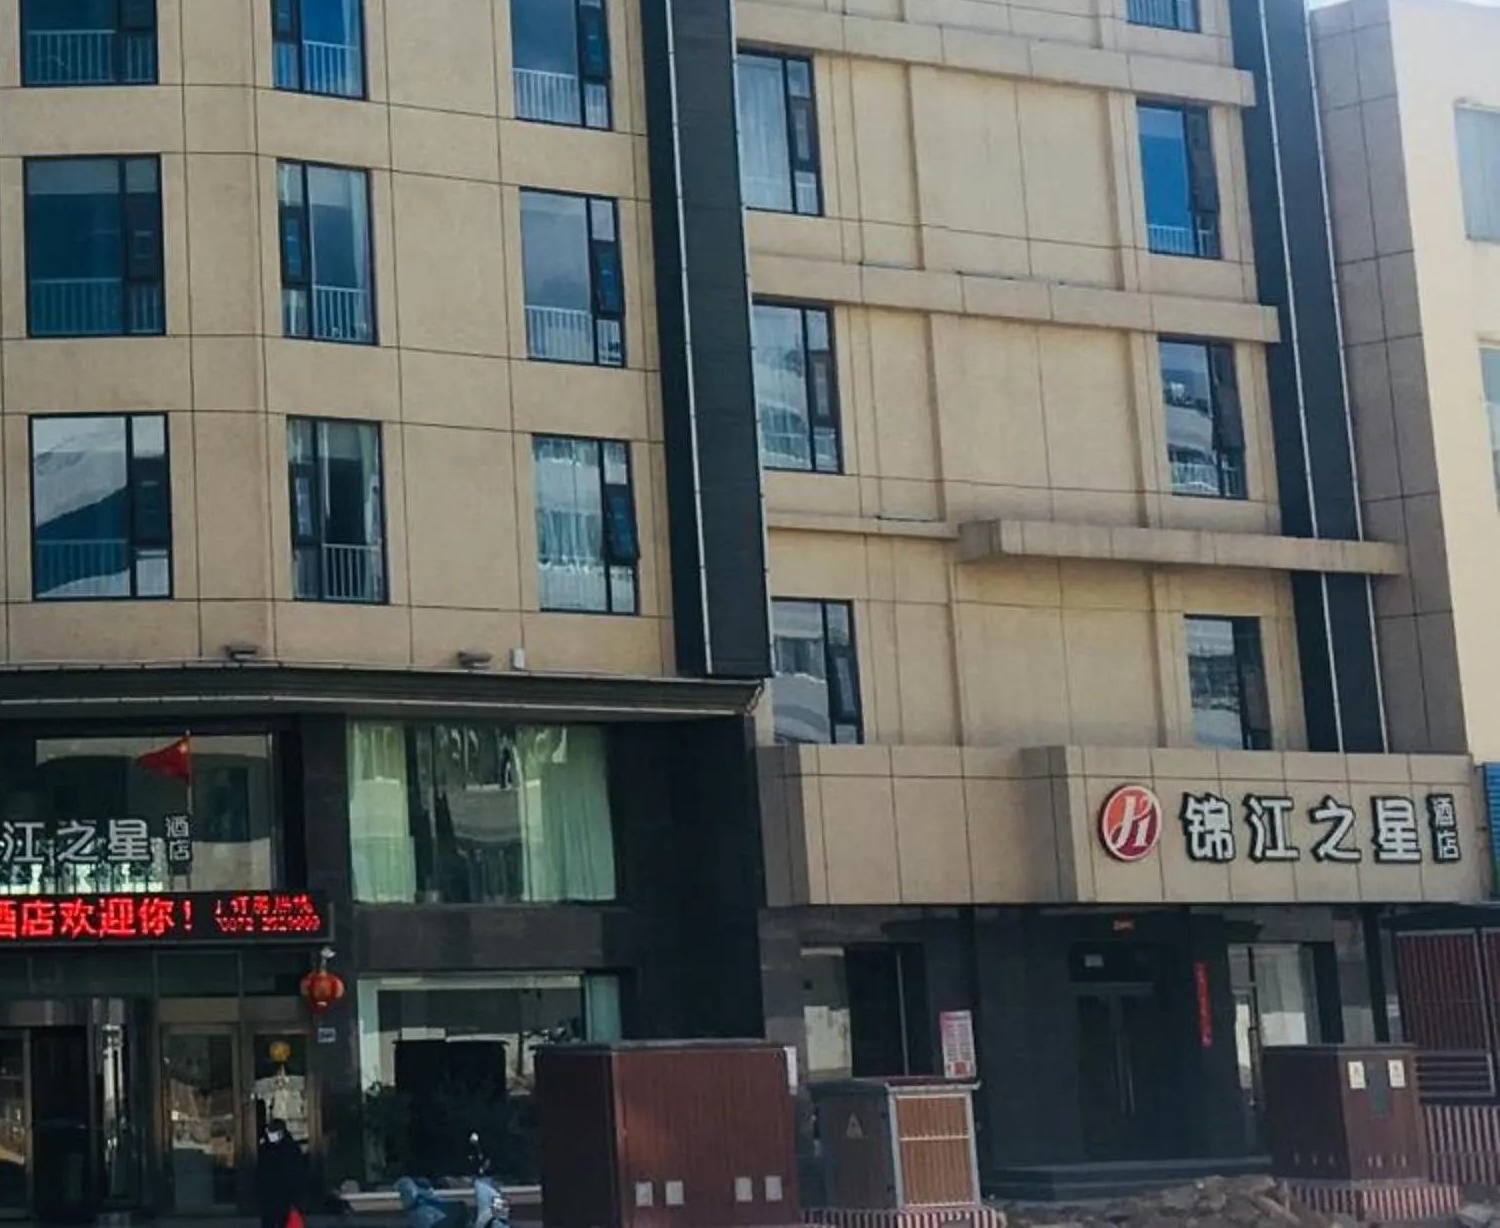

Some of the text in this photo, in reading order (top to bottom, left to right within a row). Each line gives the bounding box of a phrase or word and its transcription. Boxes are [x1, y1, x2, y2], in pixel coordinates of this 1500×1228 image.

[164, 815, 192, 862] 酒店
[1182, 792, 1422, 864] 锦江之星
[1427, 793, 1461, 863] 酒店
